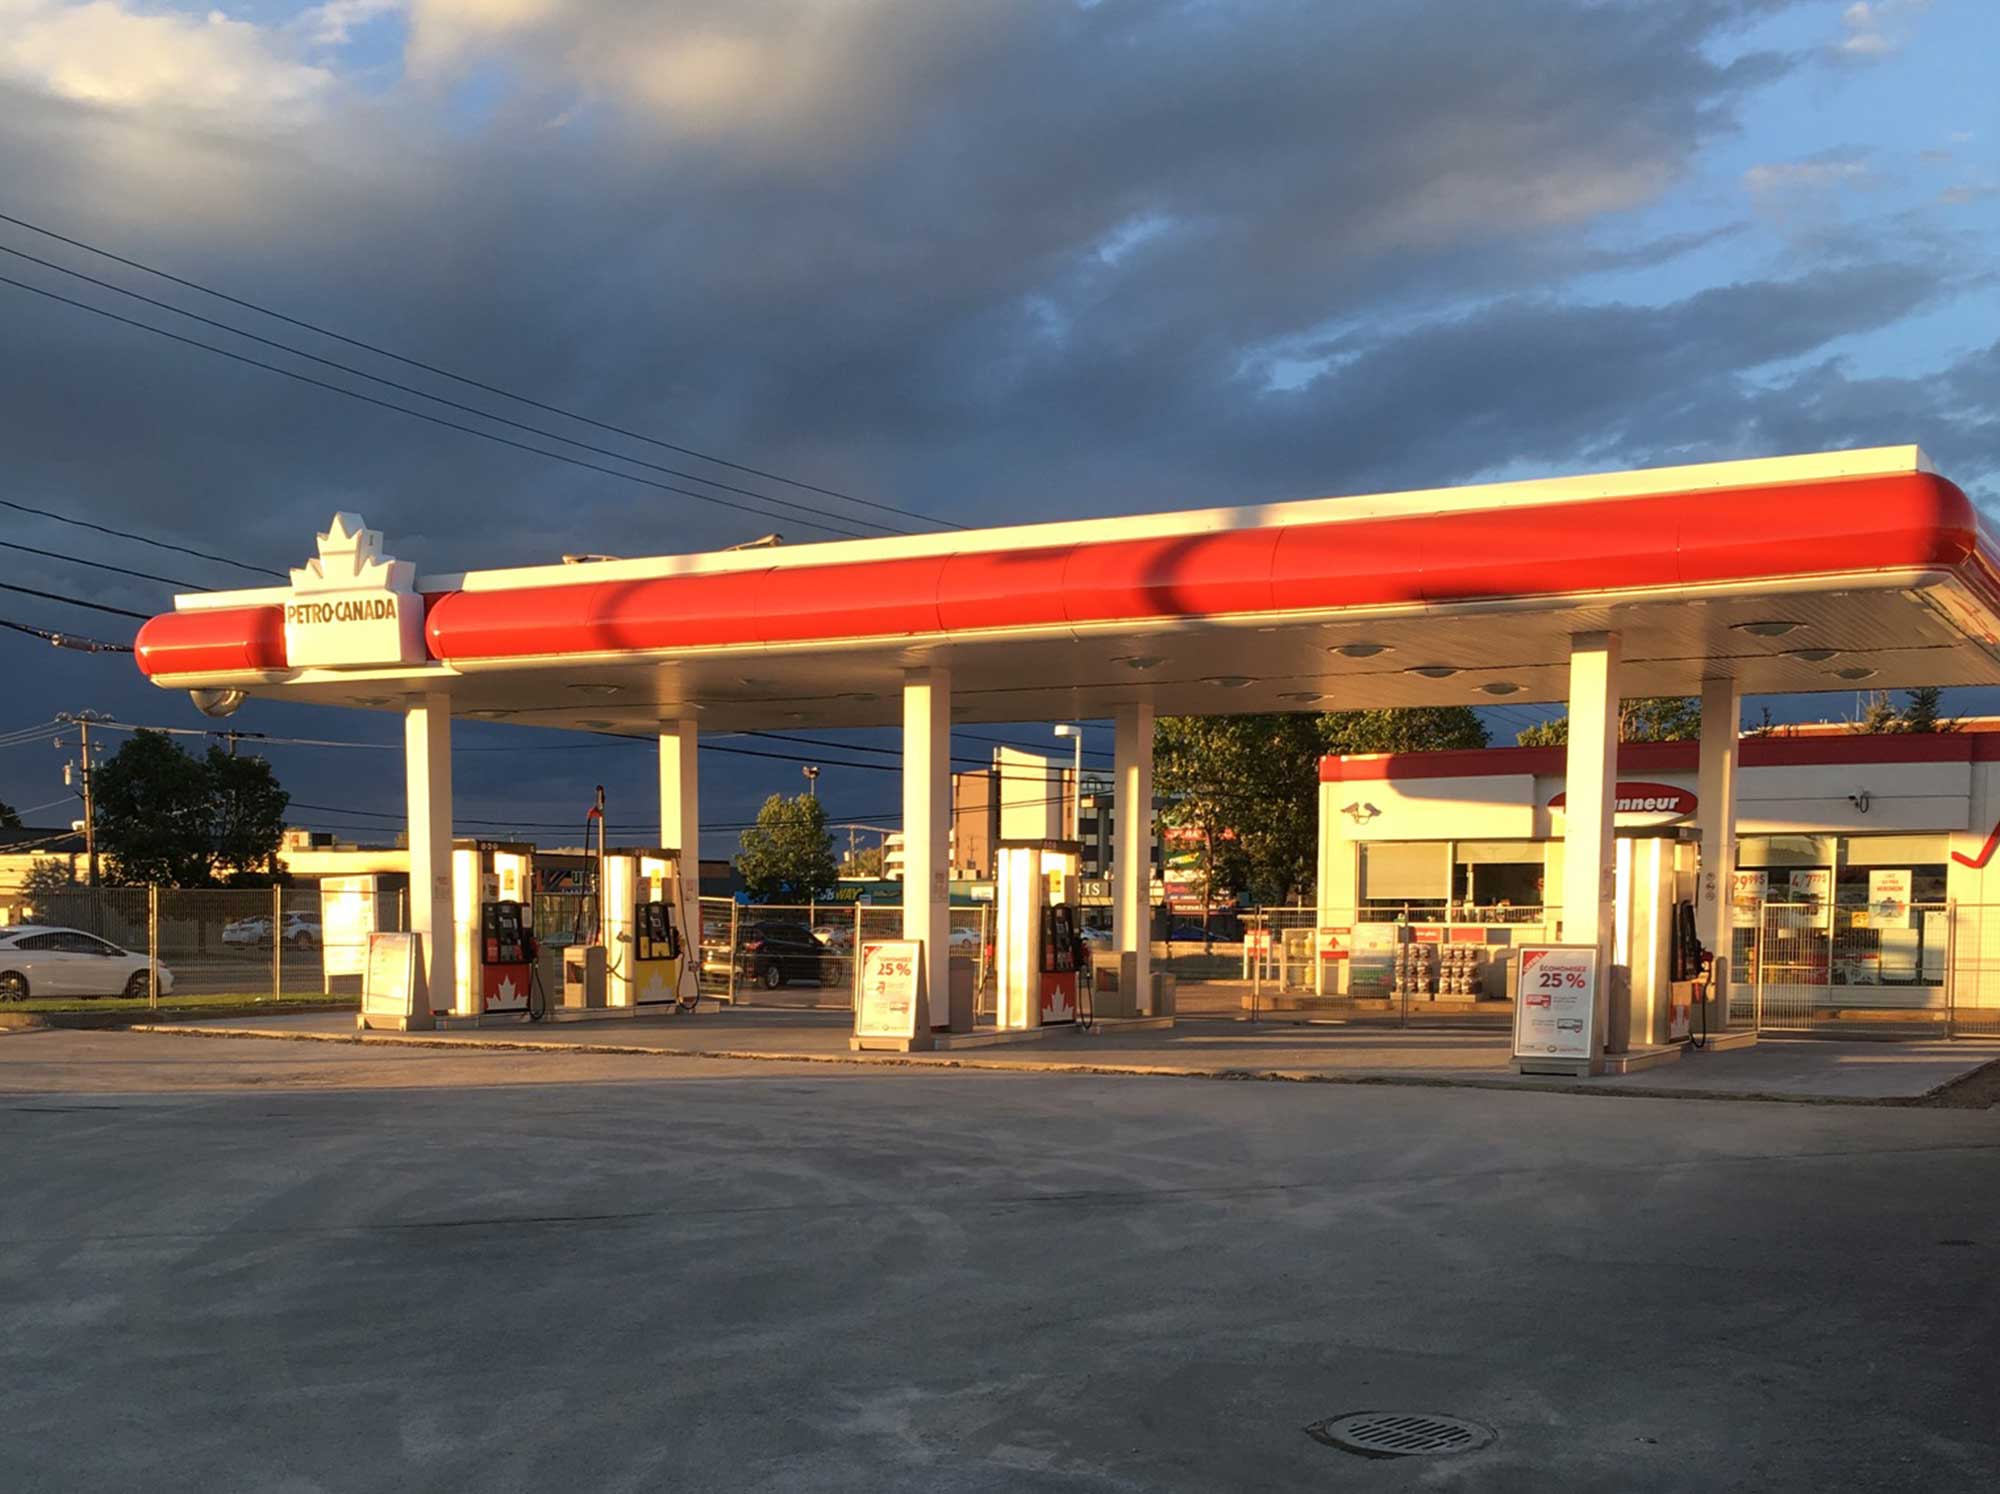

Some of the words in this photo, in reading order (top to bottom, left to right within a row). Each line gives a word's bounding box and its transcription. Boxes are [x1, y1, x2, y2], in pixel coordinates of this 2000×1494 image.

[1614, 797, 1680, 811] nneur
[877, 962, 894, 976] 25
[896, 962, 912, 977] %
[1539, 972, 1563, 988] 25
[1566, 973, 1586, 989] %
